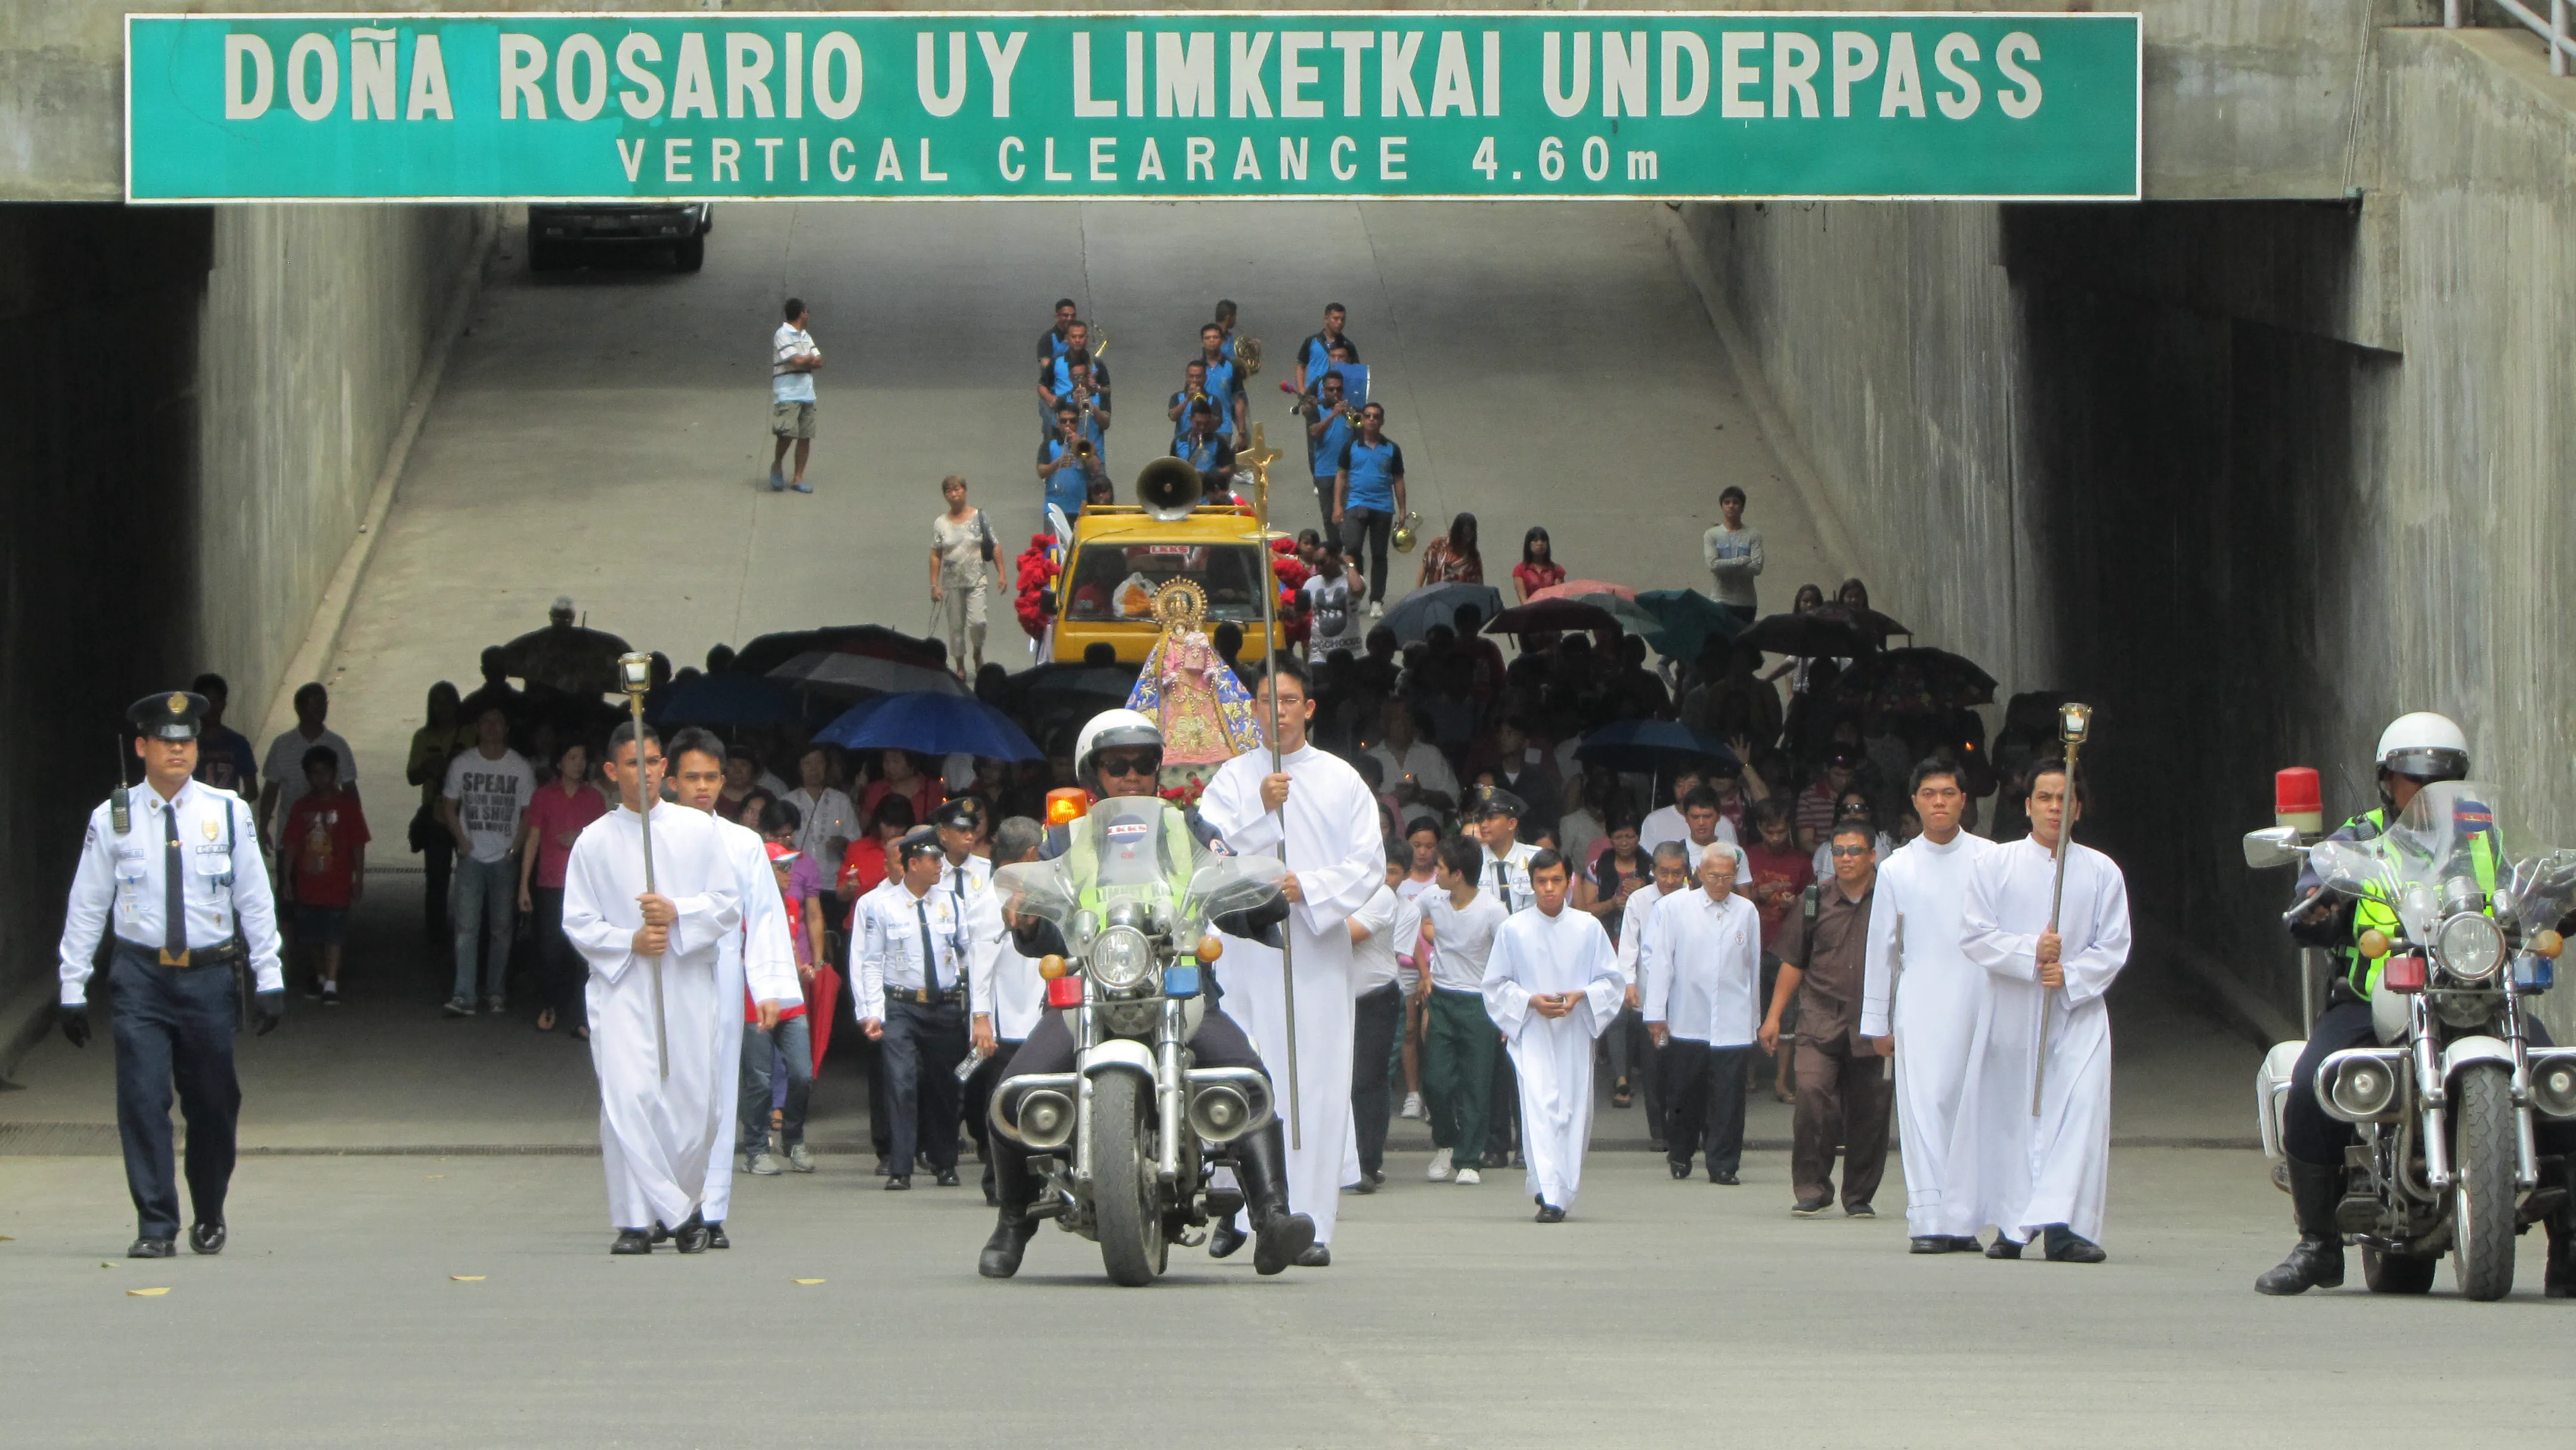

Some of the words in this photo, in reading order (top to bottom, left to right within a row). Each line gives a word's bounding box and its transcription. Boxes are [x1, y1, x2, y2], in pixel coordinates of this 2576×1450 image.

[225, 27, 454, 121] DOÑA
[500, 32, 863, 121] ROSARIO
[917, 32, 1029, 117] UY
[1073, 31, 1500, 117] LIMKETKAI
[1543, 31, 2042, 119] UNDERPASS
[616, 138, 948, 181] VERTICAL
[999, 136, 1407, 181] CLEARANCE
[462, 772, 519, 794] SPEAK
